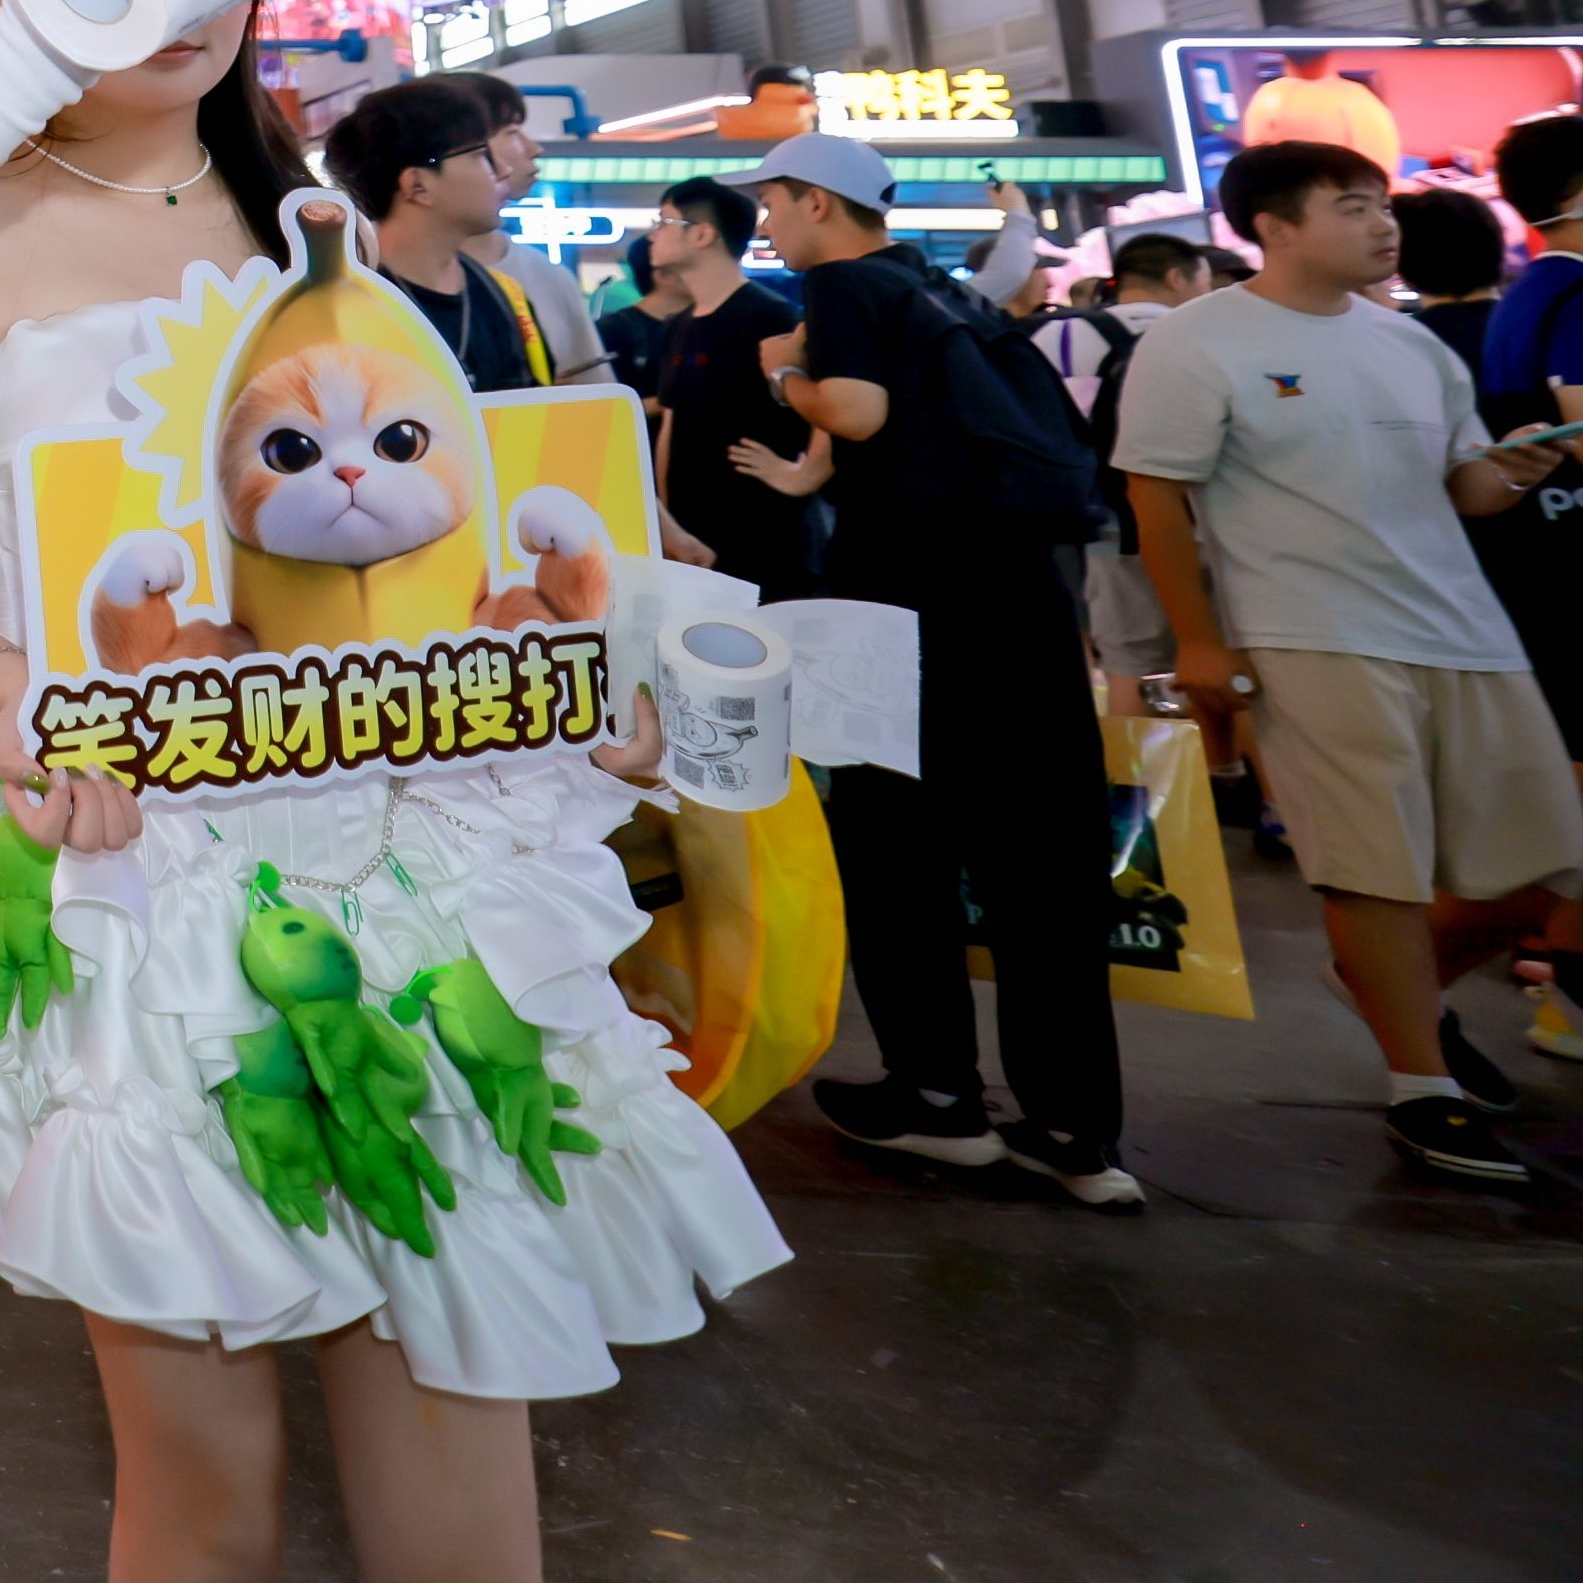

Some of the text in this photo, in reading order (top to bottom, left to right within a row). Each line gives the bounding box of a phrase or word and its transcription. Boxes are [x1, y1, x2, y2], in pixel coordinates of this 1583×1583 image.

[37, 637, 606, 789] 笑发财的搜打
